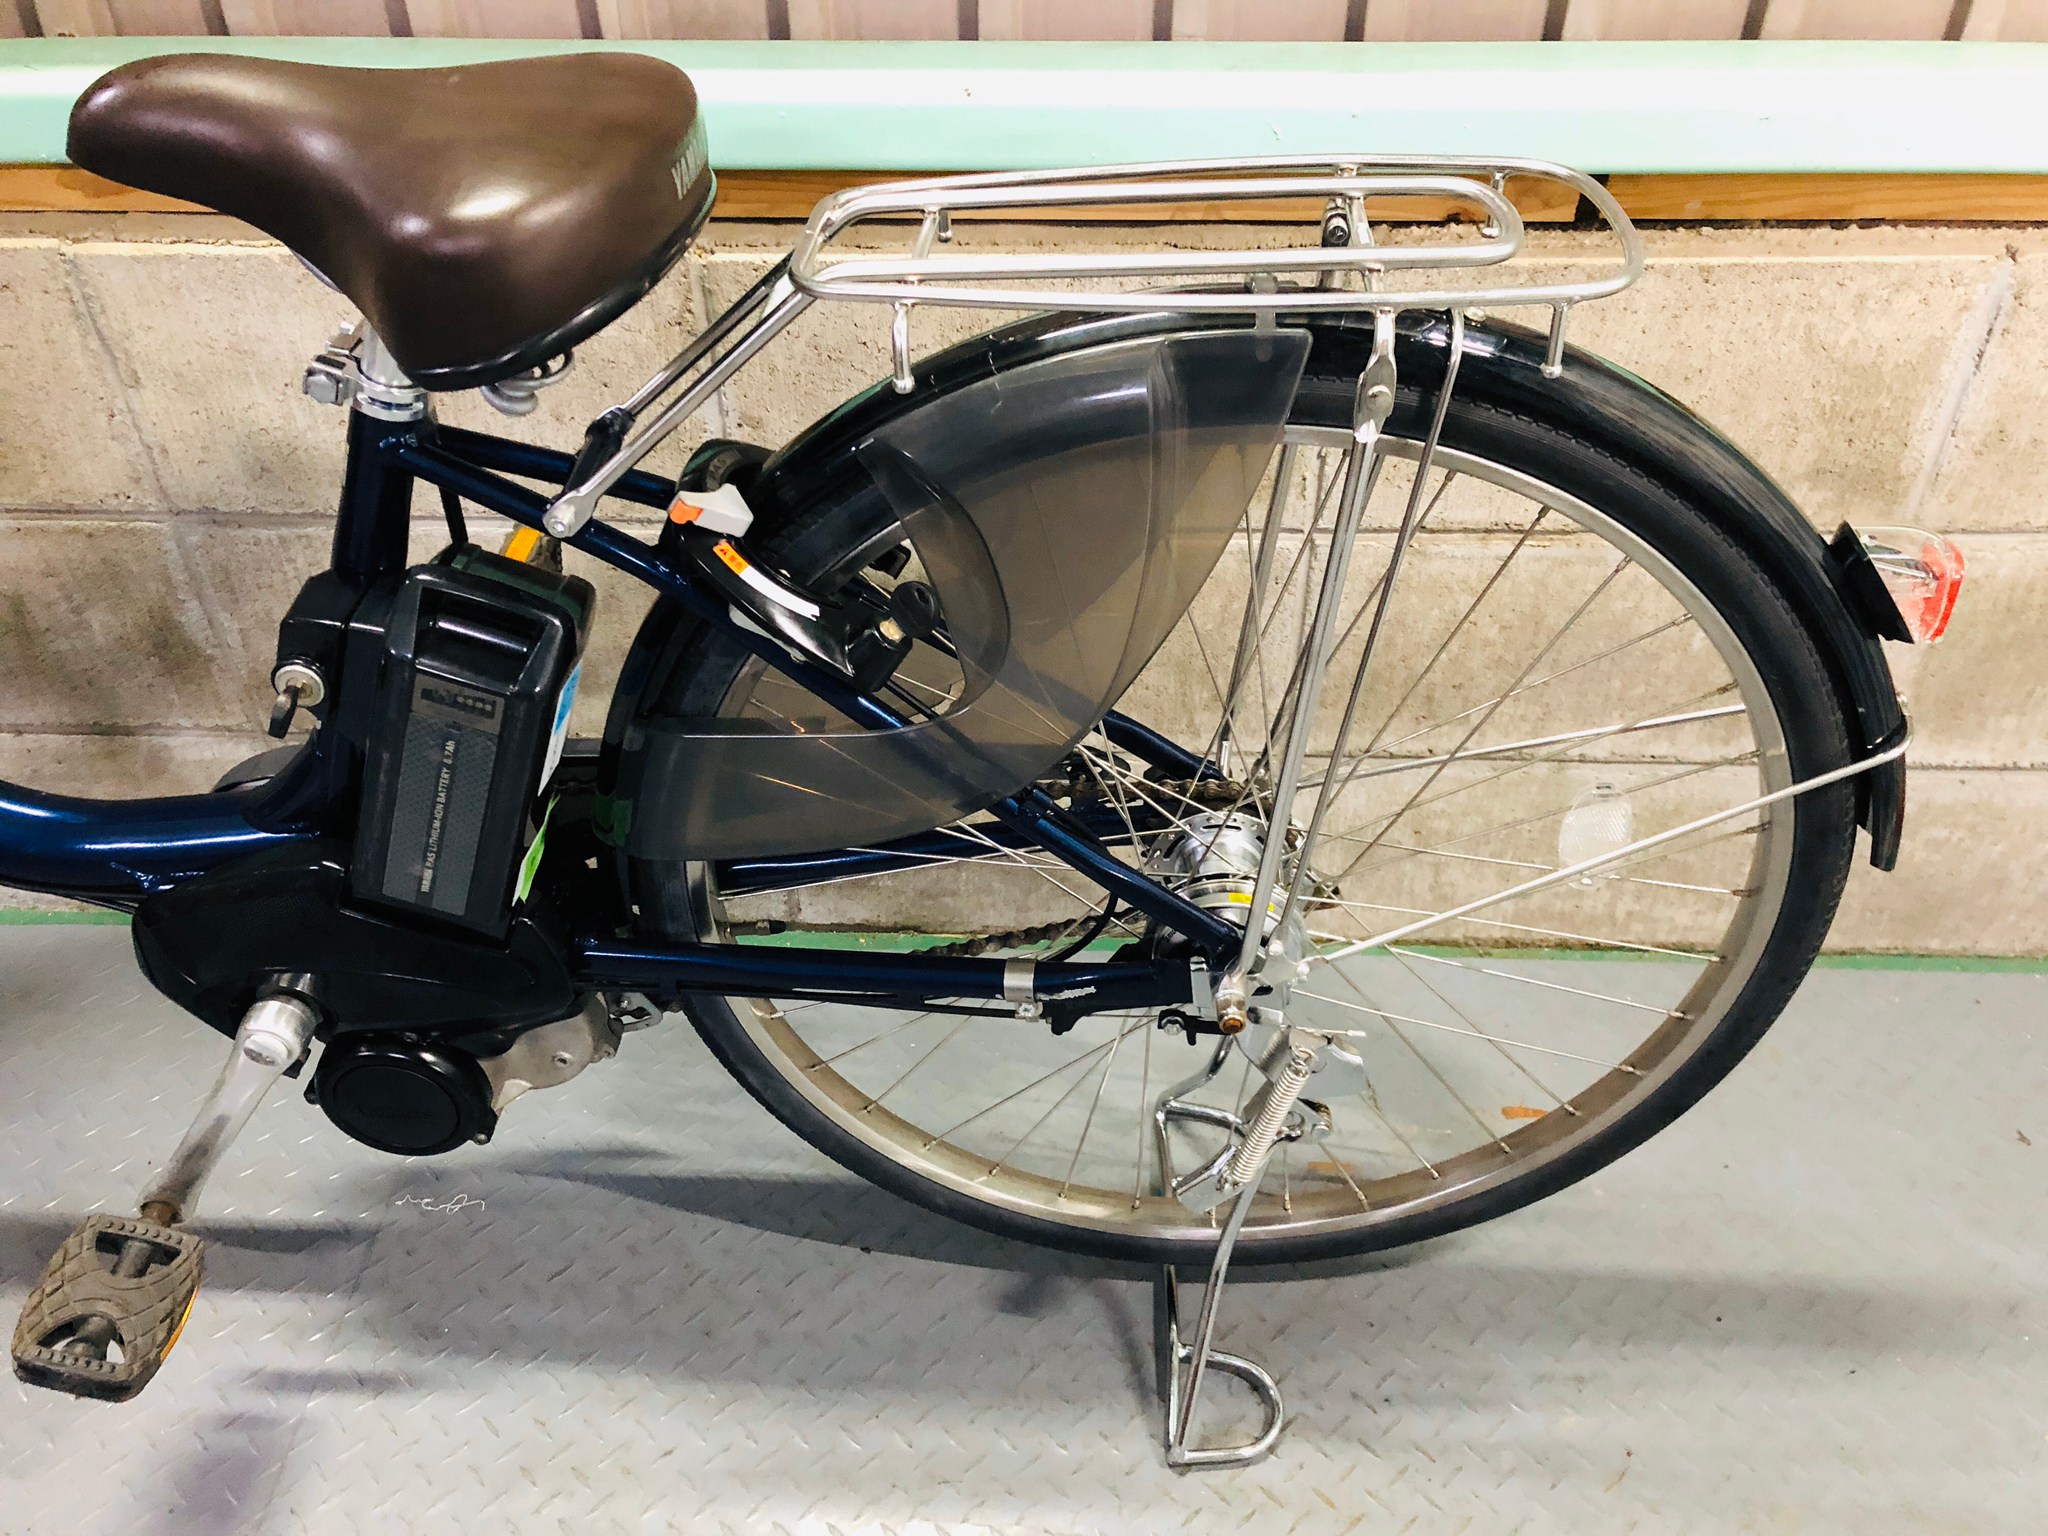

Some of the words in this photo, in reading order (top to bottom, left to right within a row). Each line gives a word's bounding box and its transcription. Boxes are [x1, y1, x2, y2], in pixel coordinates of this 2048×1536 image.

[436, 767, 451, 803] BATTERY
[428, 803, 445, 851] LITHIUM-ION
[425, 852, 436, 868] PAS
